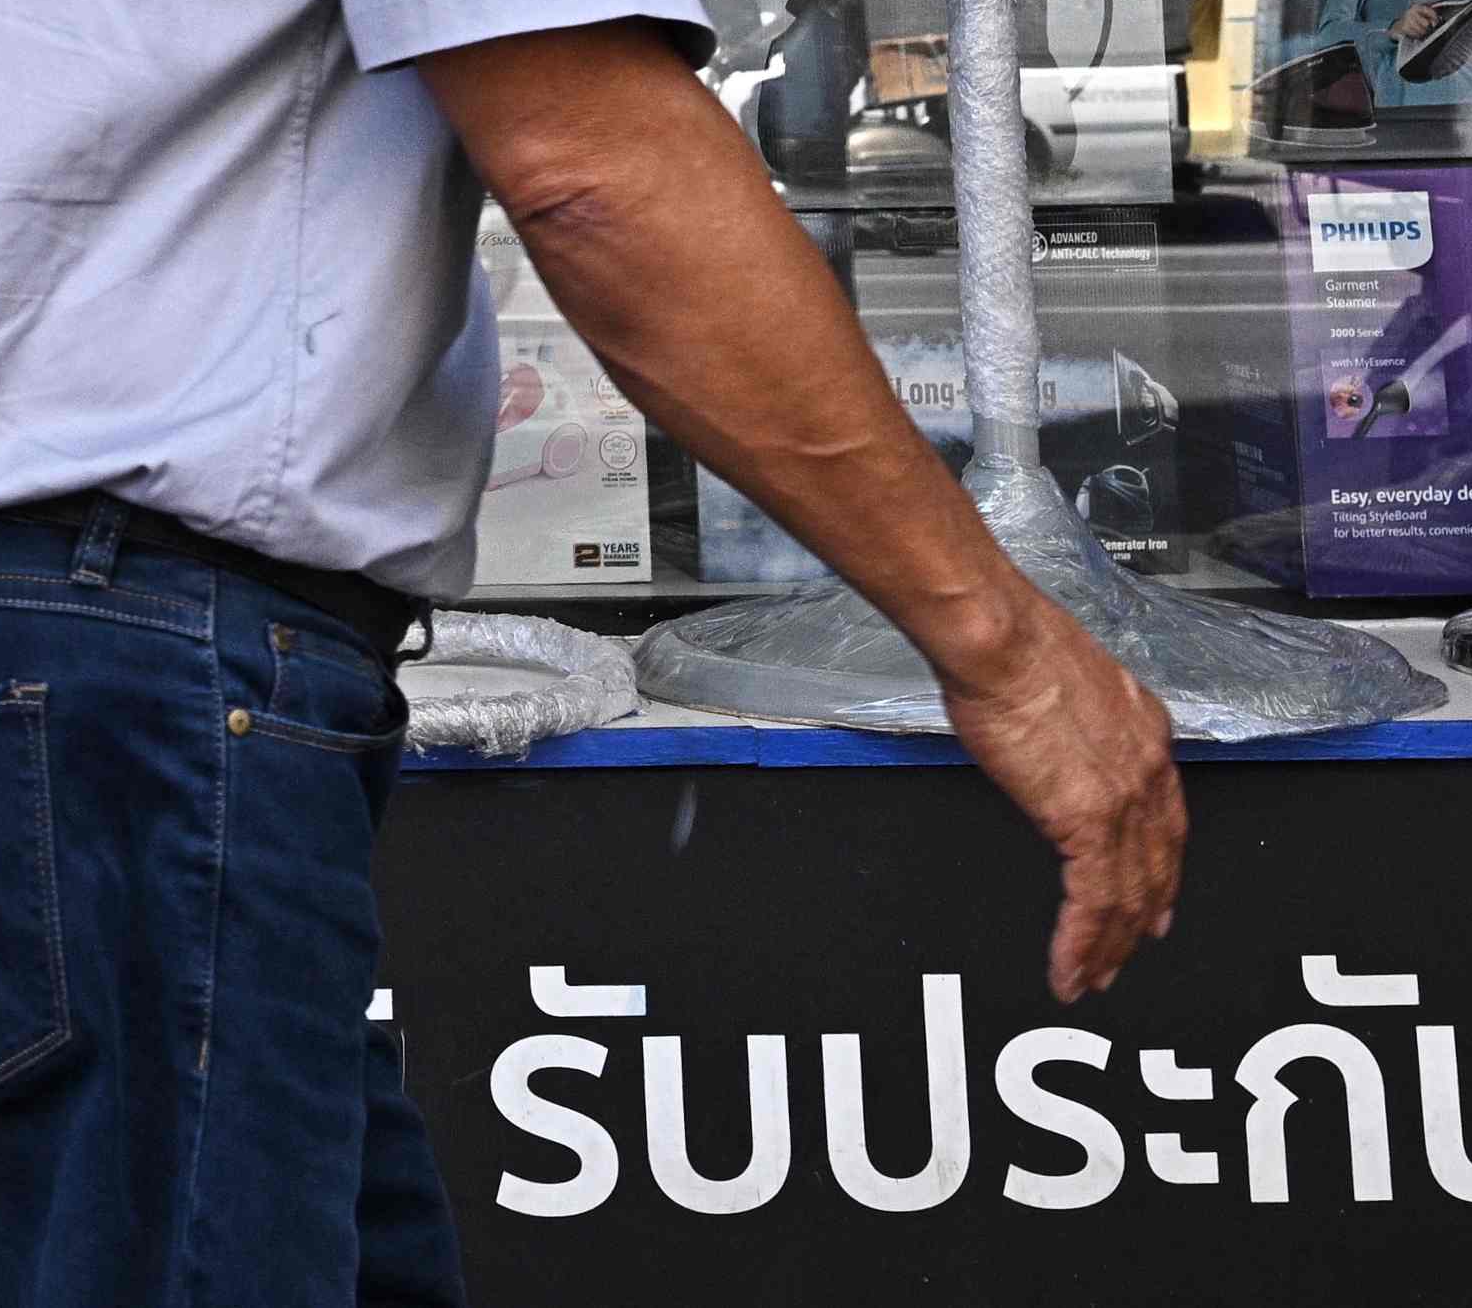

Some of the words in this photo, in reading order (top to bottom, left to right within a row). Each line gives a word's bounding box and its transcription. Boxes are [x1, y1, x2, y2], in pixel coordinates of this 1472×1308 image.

[1050, 232, 1098, 244] ADVANCED
[1320, 221, 1422, 243] PHILIPS
[1050, 247, 1099, 260] ANTI-CALC
[1325, 279, 1379, 293] Garment
[1326, 296, 1378, 309] Steamer
[1329, 328, 1356, 338] 3000
[1357, 327, 1386, 338] Series
[1331, 357, 1353, 367] with
[1355, 356, 1406, 369] MyEssence
[1331, 488, 1369, 507] Easy,
[1376, 488, 1454, 507] everyday
[1332, 511, 1367, 525] Tilting
[1369, 510, 1428, 524] StyleBoard
[1333, 526, 1350, 539] for
[1352, 525, 1387, 538] better
[1389, 525, 1426, 539] results,
[1149, 539, 1168, 550] Iron
[574, 543, 601, 569] 2
[603, 543, 640, 553] YEARS
